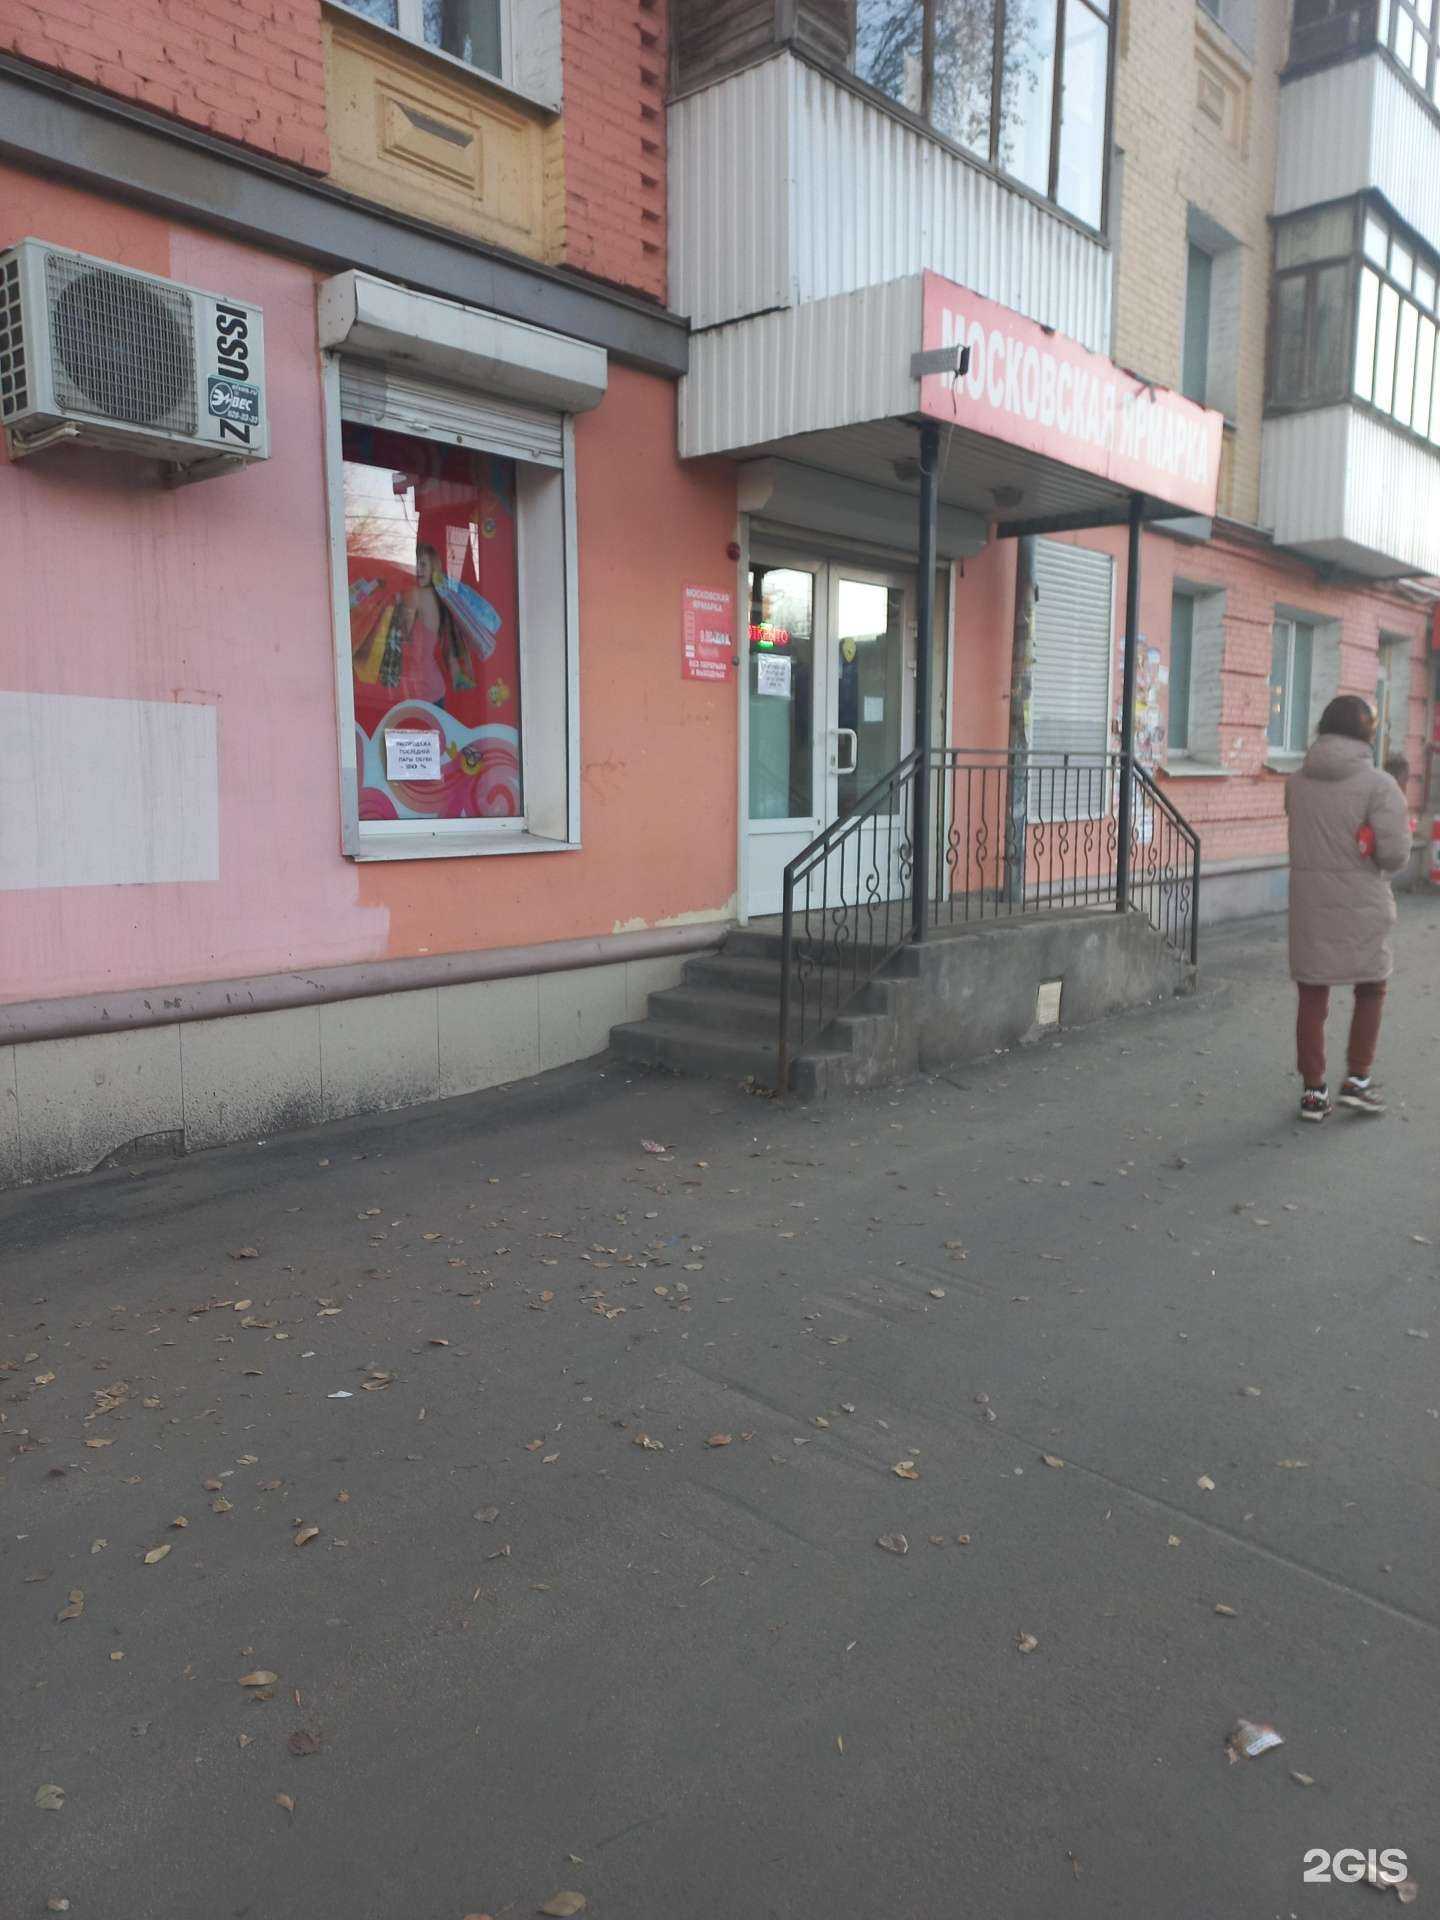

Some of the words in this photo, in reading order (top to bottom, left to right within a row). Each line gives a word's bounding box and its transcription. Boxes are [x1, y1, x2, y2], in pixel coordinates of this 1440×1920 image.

[216, 303, 250, 443] ZUSSI
[941, 308, 1115, 449] МОСКОВСКАЯ
[1119, 391, 1209, 484] ЯРМАРКА
